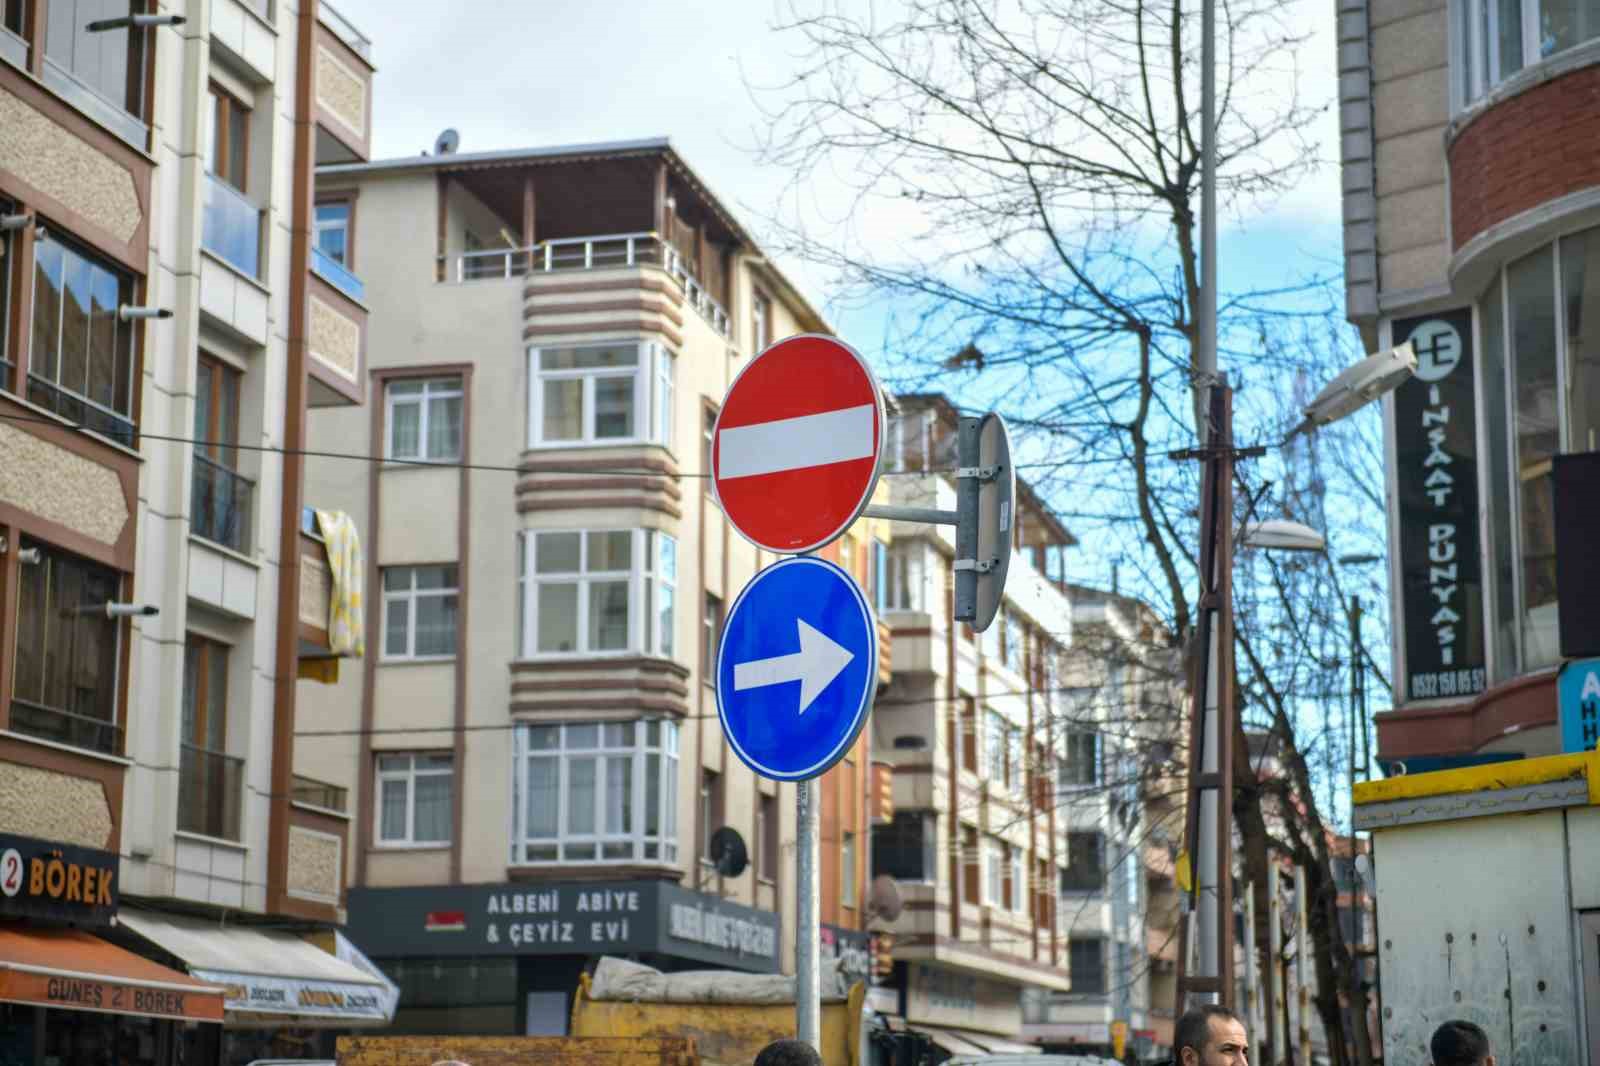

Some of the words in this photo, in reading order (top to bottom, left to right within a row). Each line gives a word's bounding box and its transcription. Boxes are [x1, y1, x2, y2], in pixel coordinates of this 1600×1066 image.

[5, 857, 18, 889] 2
[29, 849, 113, 906] BÖREK
[487, 890, 560, 914] ALBENİ
[576, 887, 640, 912] ABİYE
[487, 924, 499, 943] &
[509, 920, 574, 948] ÇEYİZ
[590, 918, 630, 942] EVİ
